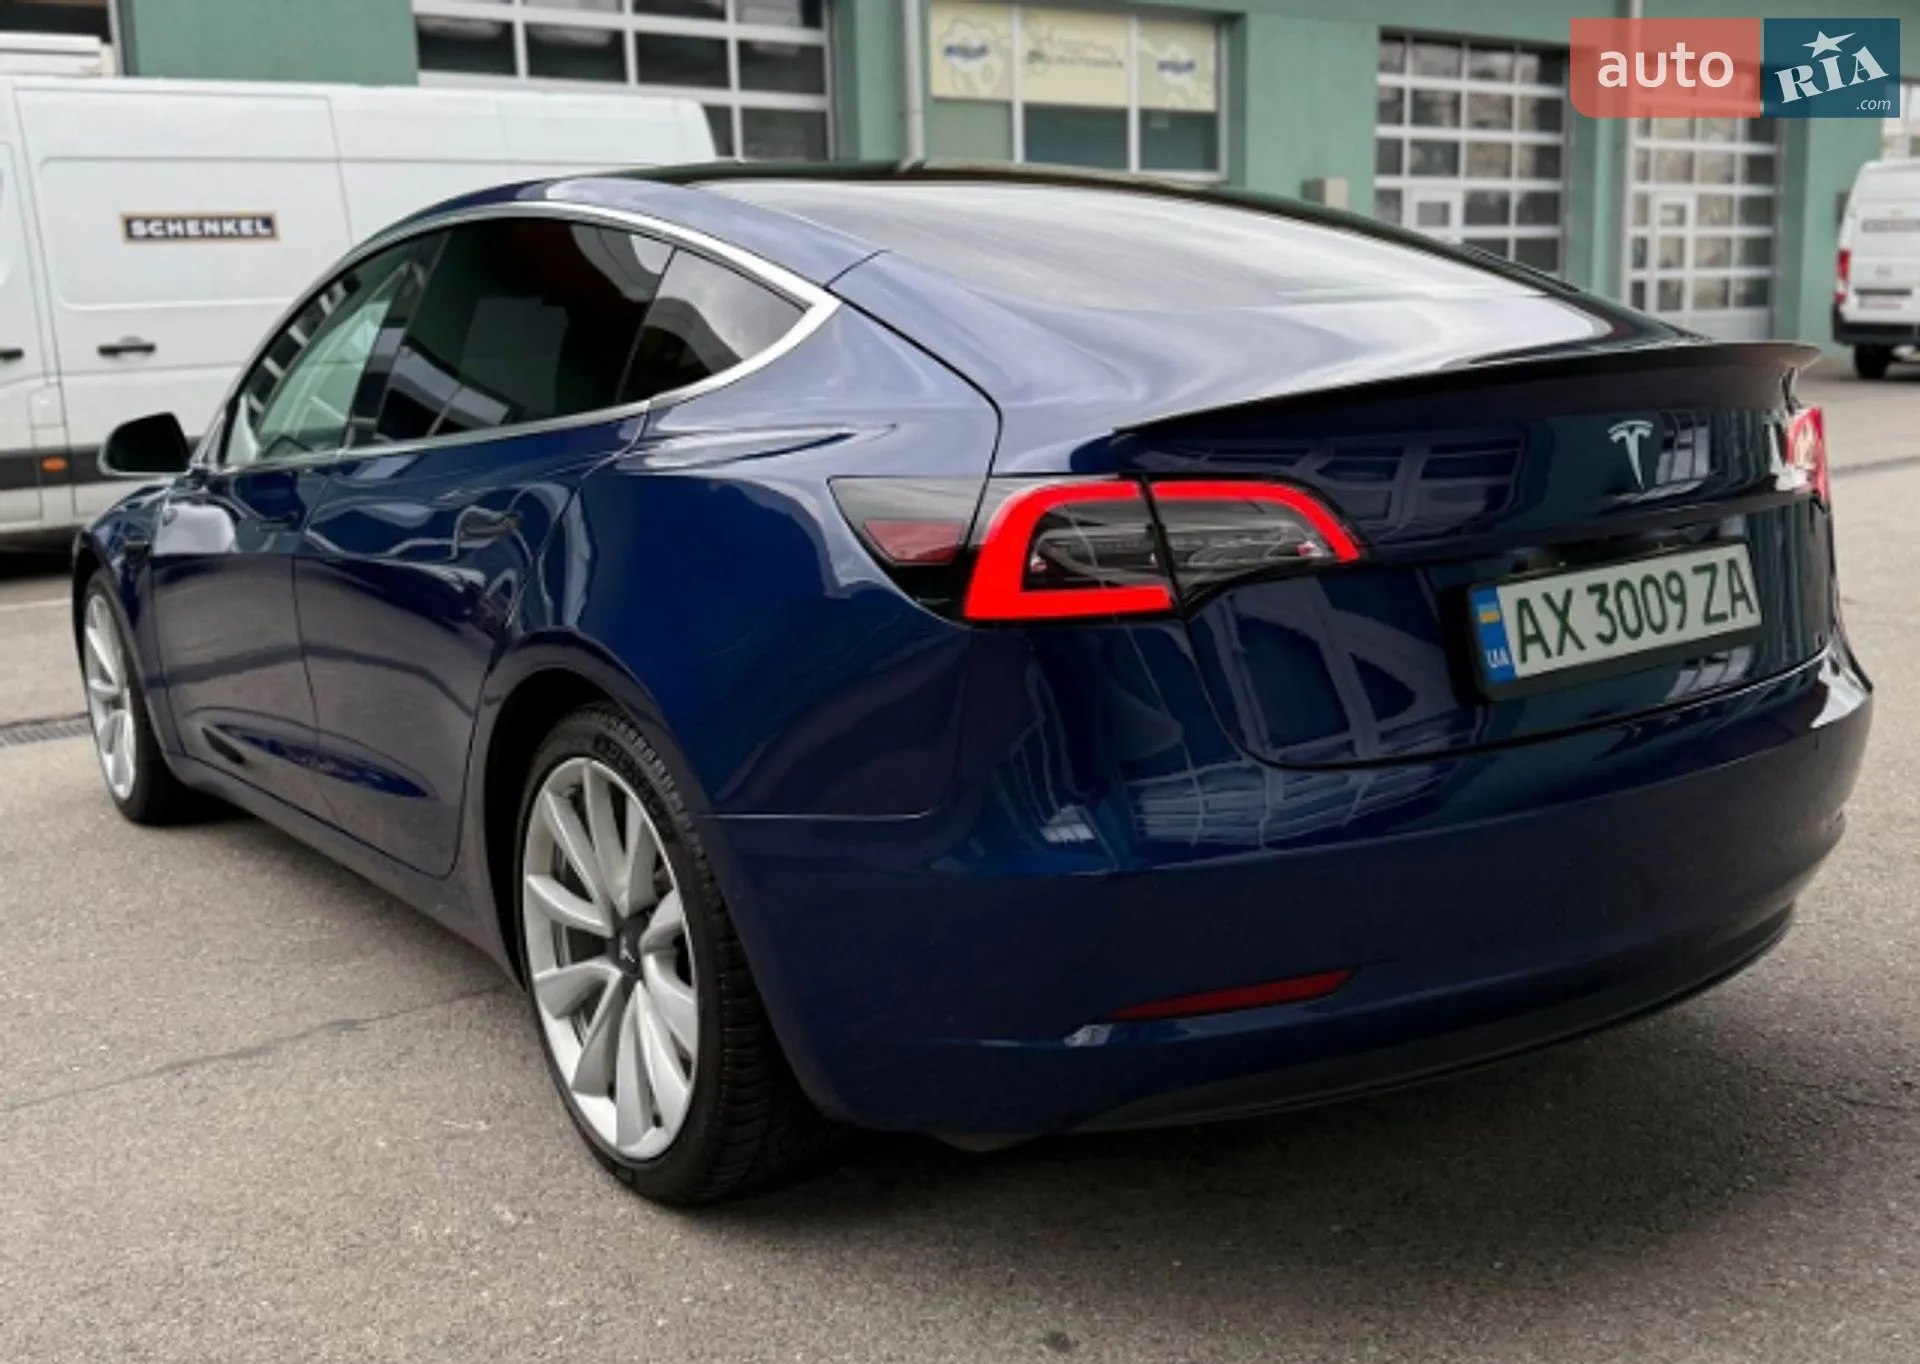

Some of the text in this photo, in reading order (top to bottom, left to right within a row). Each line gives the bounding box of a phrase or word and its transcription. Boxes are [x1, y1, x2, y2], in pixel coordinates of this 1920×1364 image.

[130, 218, 272, 237] SCHENKEL
[1516, 558, 1754, 663] AX 3009 ZA
[1486, 647, 1510, 669] UA
